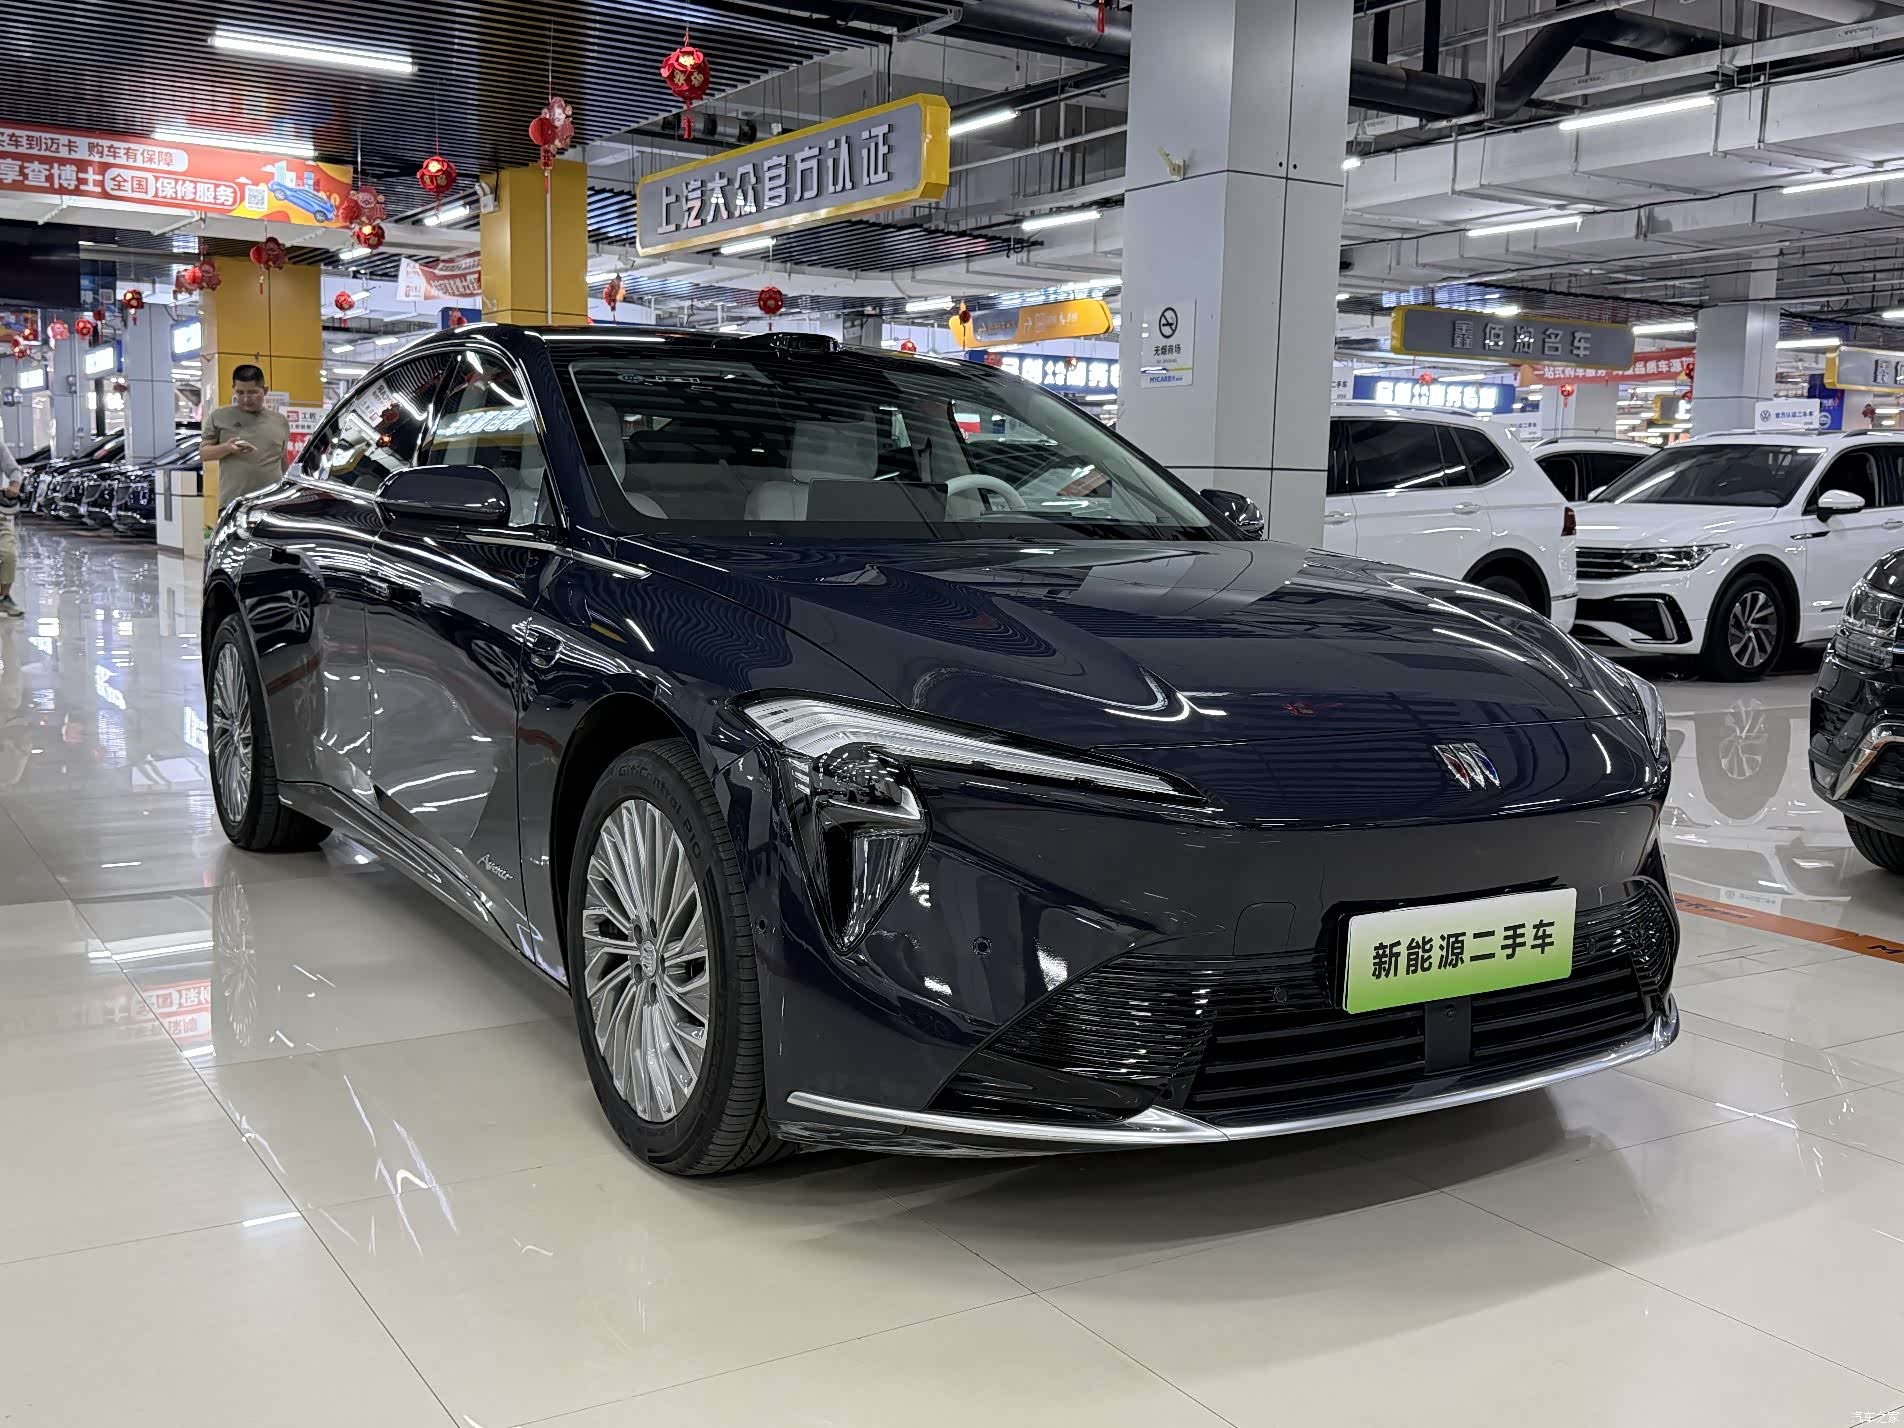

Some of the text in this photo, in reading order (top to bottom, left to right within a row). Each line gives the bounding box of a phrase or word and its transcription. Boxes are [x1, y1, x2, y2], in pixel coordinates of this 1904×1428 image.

[87, 142, 174, 168] 购车有保障
[658, 123, 893, 234] 上汽大众官方认证
[1154, 344, 1181, 356] 无烟商场
[683, 817, 701, 859] P10
[1371, 919, 1556, 980] 新能源二手车
